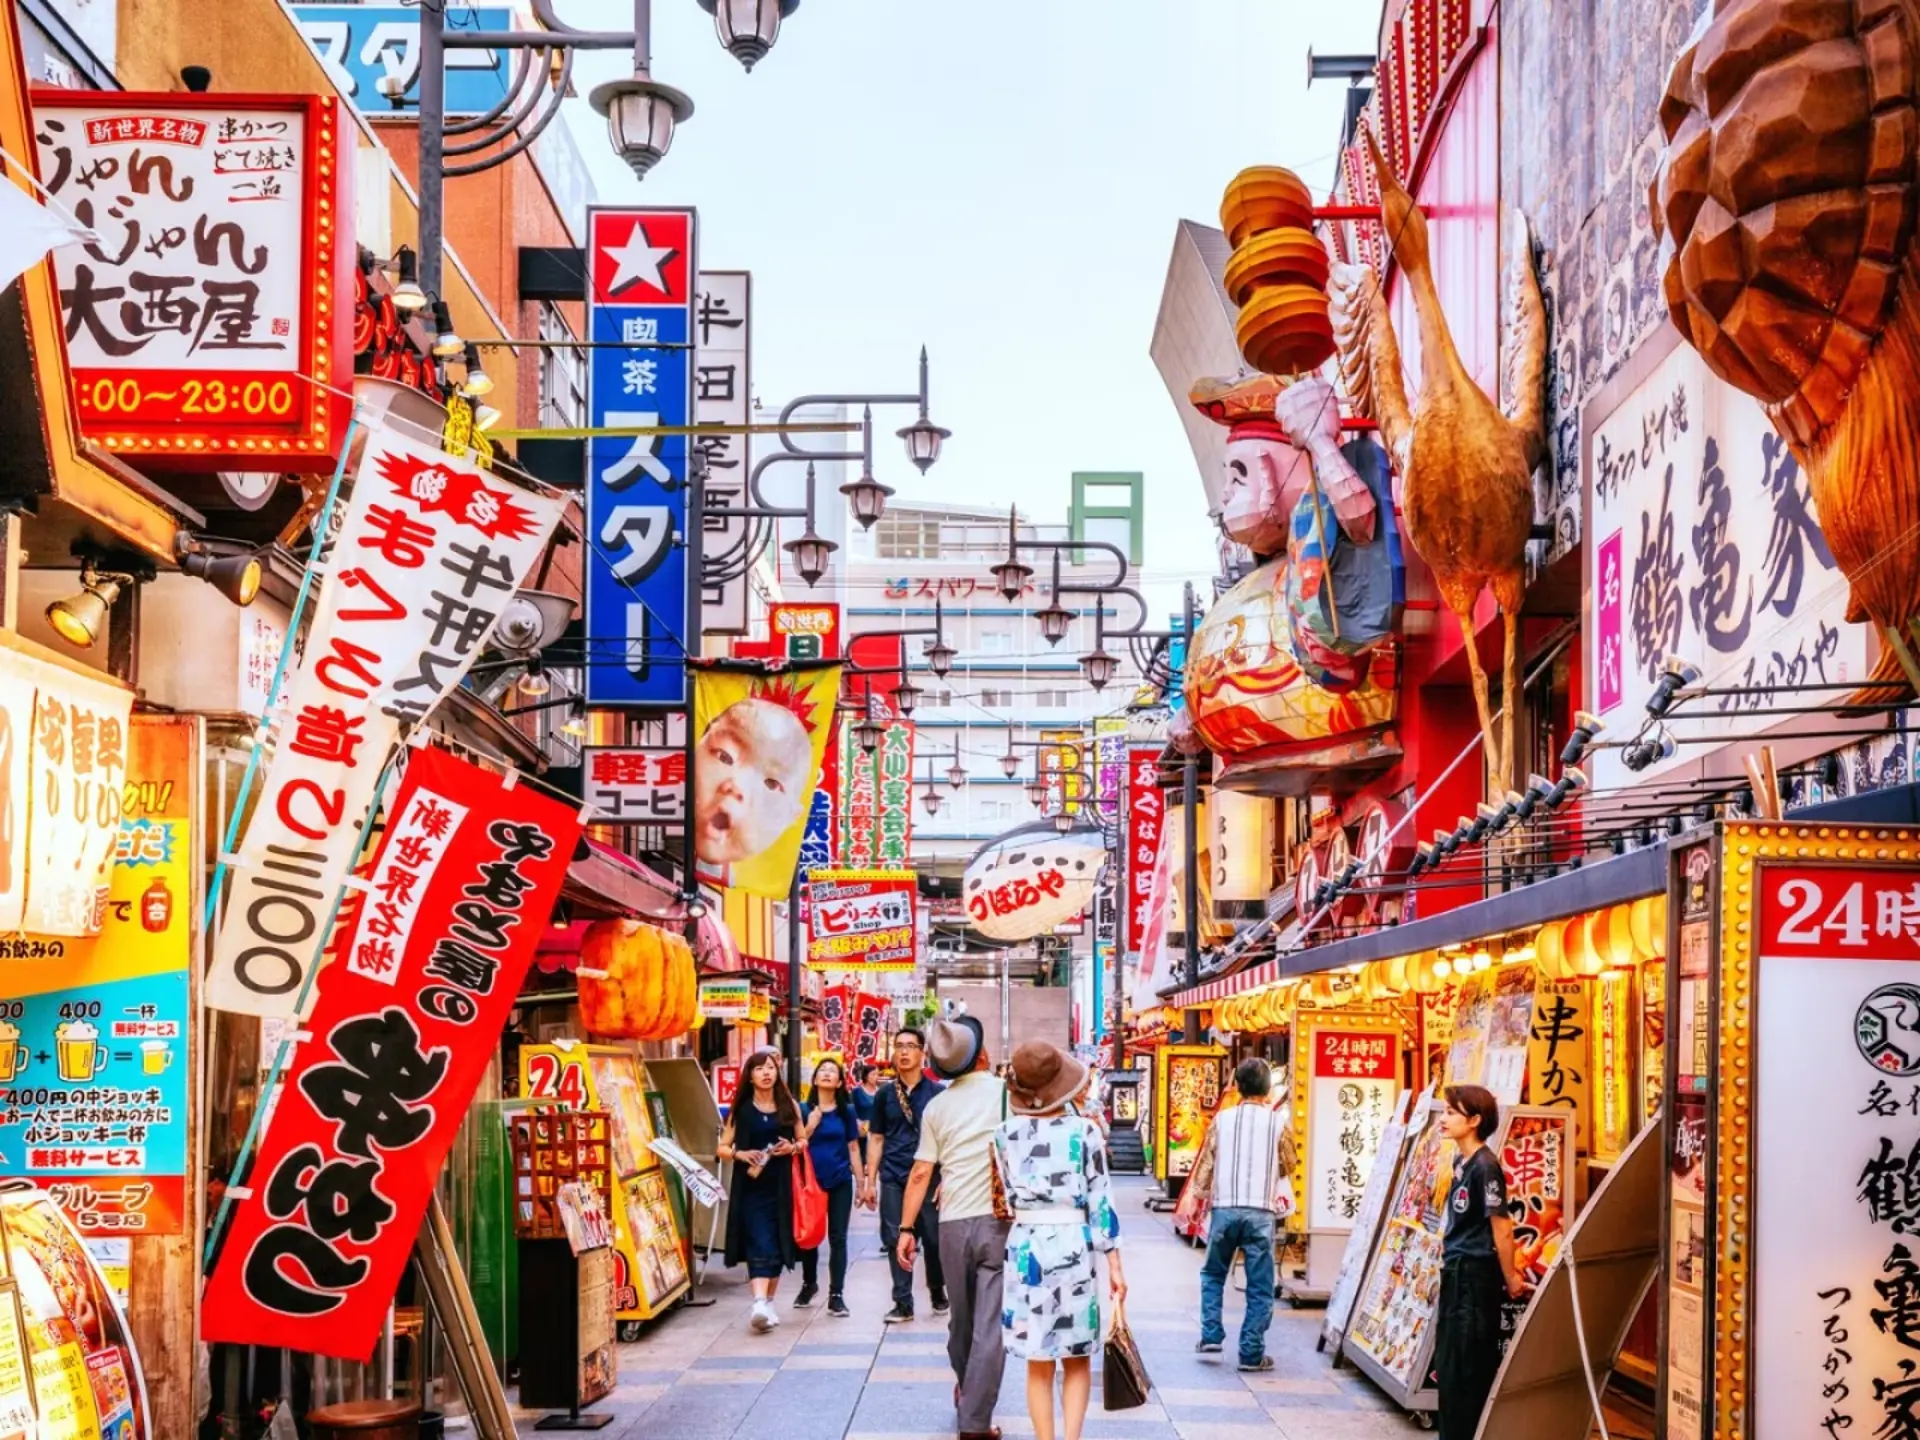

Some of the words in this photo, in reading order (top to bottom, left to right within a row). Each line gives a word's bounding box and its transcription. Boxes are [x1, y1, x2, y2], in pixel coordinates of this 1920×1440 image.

[91, 118, 199, 145] 新世界名物
[218, 116, 288, 142] 串かつ
[213, 146, 296, 170] どて焼き
[231, 175, 281, 197] 一品
[76, 197, 268, 274] じゃん
[62, 264, 286, 358] 大西屋
[623, 317, 658, 396] 喫茶
[74, 378, 291, 415] :00～23:00
[600, 411, 675, 675] スター
[1630, 432, 1836, 683] 鶴亀家
[1599, 551, 1622, 694] 名代
[1717, 619, 1840, 714] つるかめや
[596, 789, 685, 815] コーヒ
[968, 867, 1065, 921] づぼらや
[109, 901, 132, 921] で
[59, 1002, 101, 1018] 400
[124, 1005, 156, 1018] 一杯
[114, 1022, 176, 1036] 無料サービス
[1325, 1036, 1387, 1057] 24時間
[1531, 996, 1584, 1109] 串かつ
[1332, 1057, 1379, 1074] 営業中
[7, 1089, 160, 1106] 400円の中ジョッキ
[6, 1109, 169, 1123] お一人で二杯お飲みの方に
[25, 1127, 146, 1143] 小ジョッキ一杯
[31, 1149, 141, 1167] 無料サービス
[80, 1212, 145, 1228] 5号店
[1817, 1286, 1853, 1440] つるかめや
